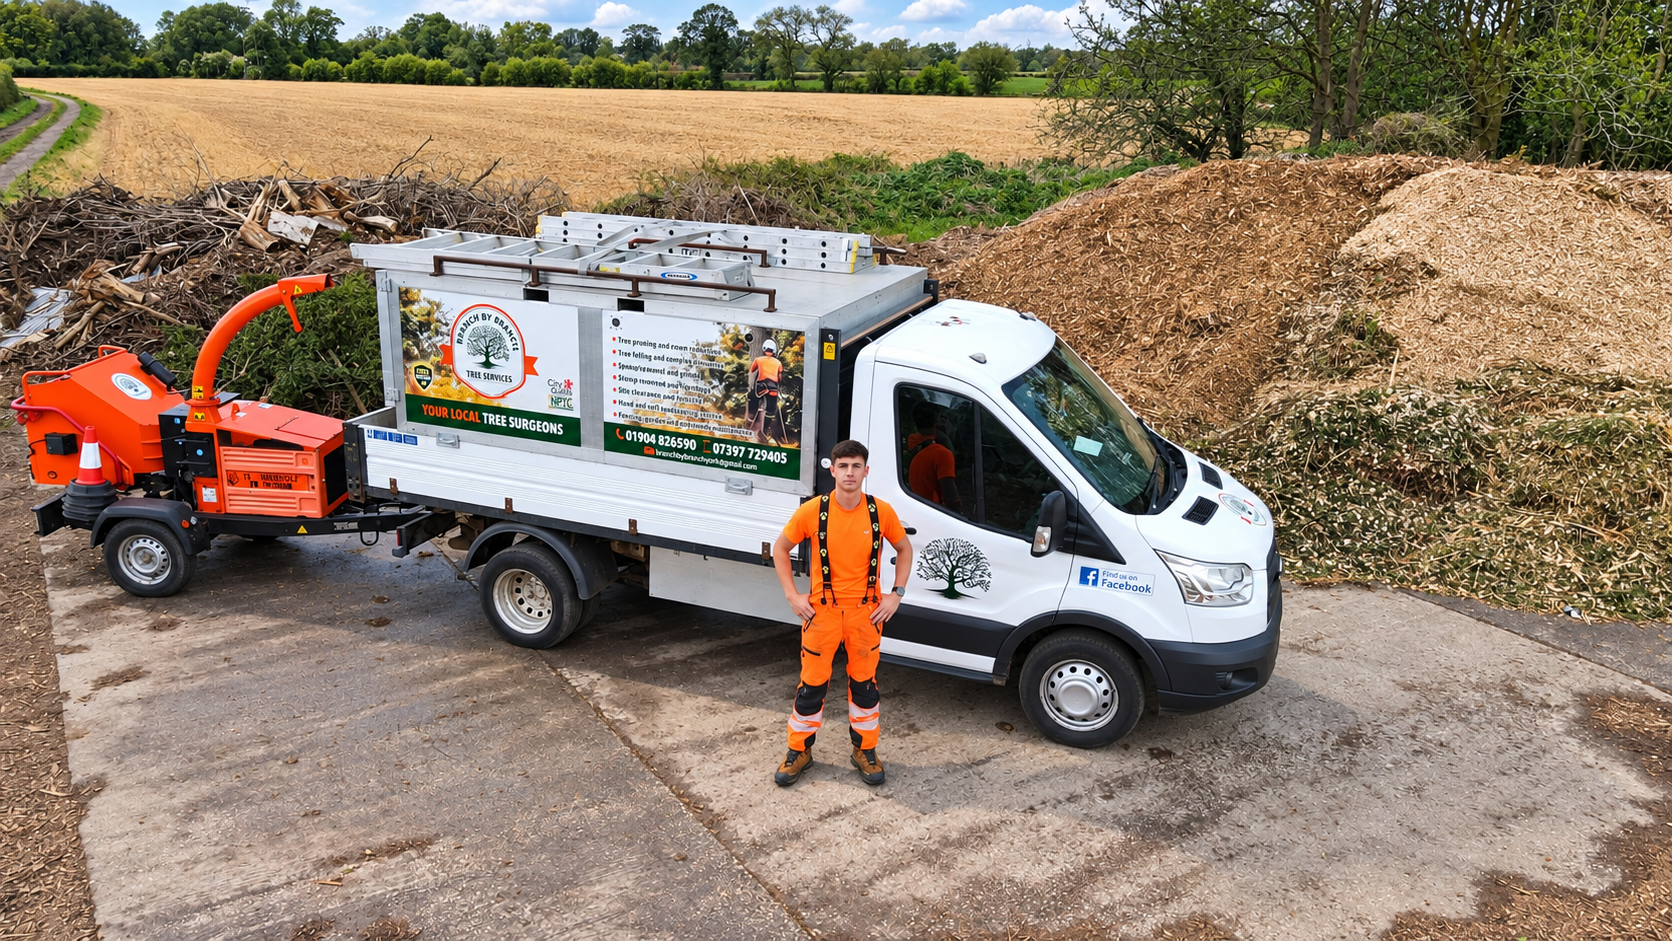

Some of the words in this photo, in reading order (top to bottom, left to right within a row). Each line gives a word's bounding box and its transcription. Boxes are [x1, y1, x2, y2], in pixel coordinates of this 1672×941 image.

[481, 312, 492, 321] BY
[618, 336, 631, 345] Tree
[618, 349, 631, 357] Tree
[466, 370, 482, 379] TREE
[483, 372, 513, 383] SERVICES
[422, 404, 449, 419] YOUR
[450, 408, 481, 423] LOCAL
[482, 412, 507, 427] TREE
[508, 416, 564, 435] SURGEONS
[625, 429, 656, 446] 01904
[658, 434, 697, 450] 826590
[712, 442, 745, 458] 07397
[748, 448, 788, 464] 729405
[1102, 570, 1119, 579] Find
[1101, 578, 1152, 594] Facebook
